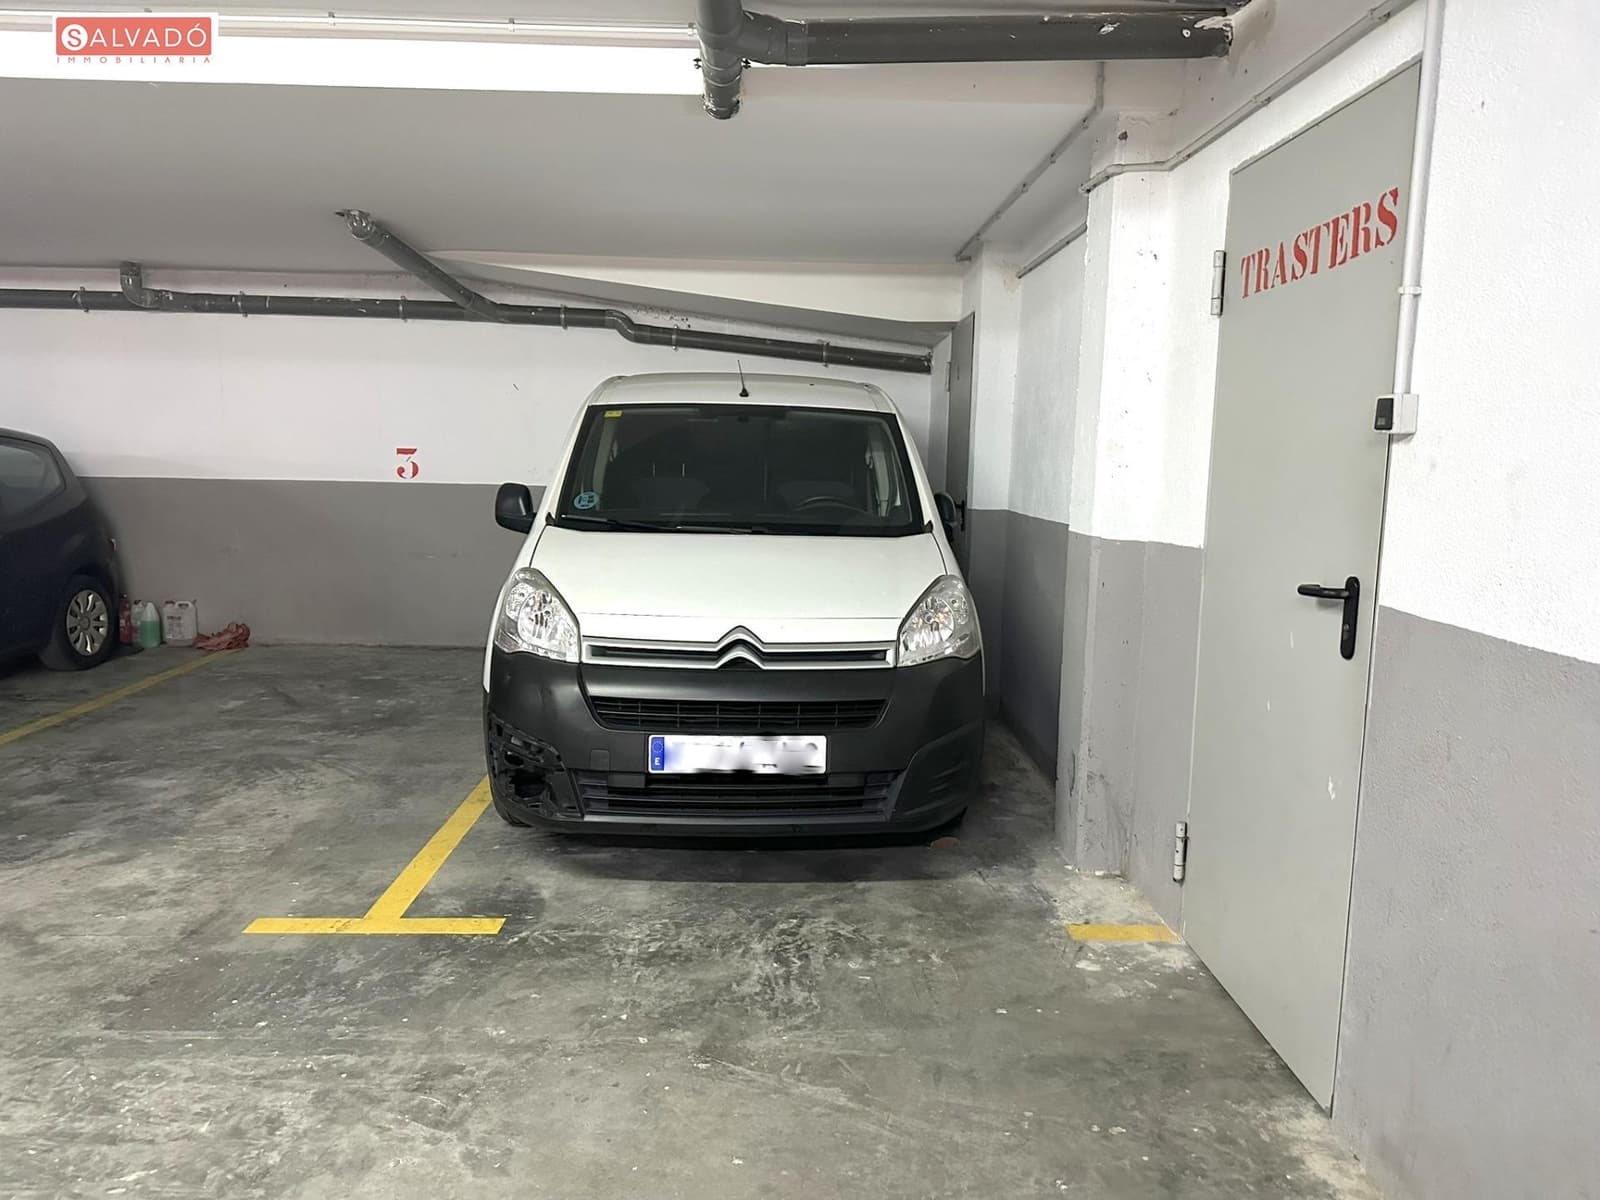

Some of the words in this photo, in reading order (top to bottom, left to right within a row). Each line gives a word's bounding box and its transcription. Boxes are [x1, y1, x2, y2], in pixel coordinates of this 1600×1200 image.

[1240, 187, 1399, 299] TRASTERS
[396, 447, 419, 479] 3
[655, 757, 661, 766] E
